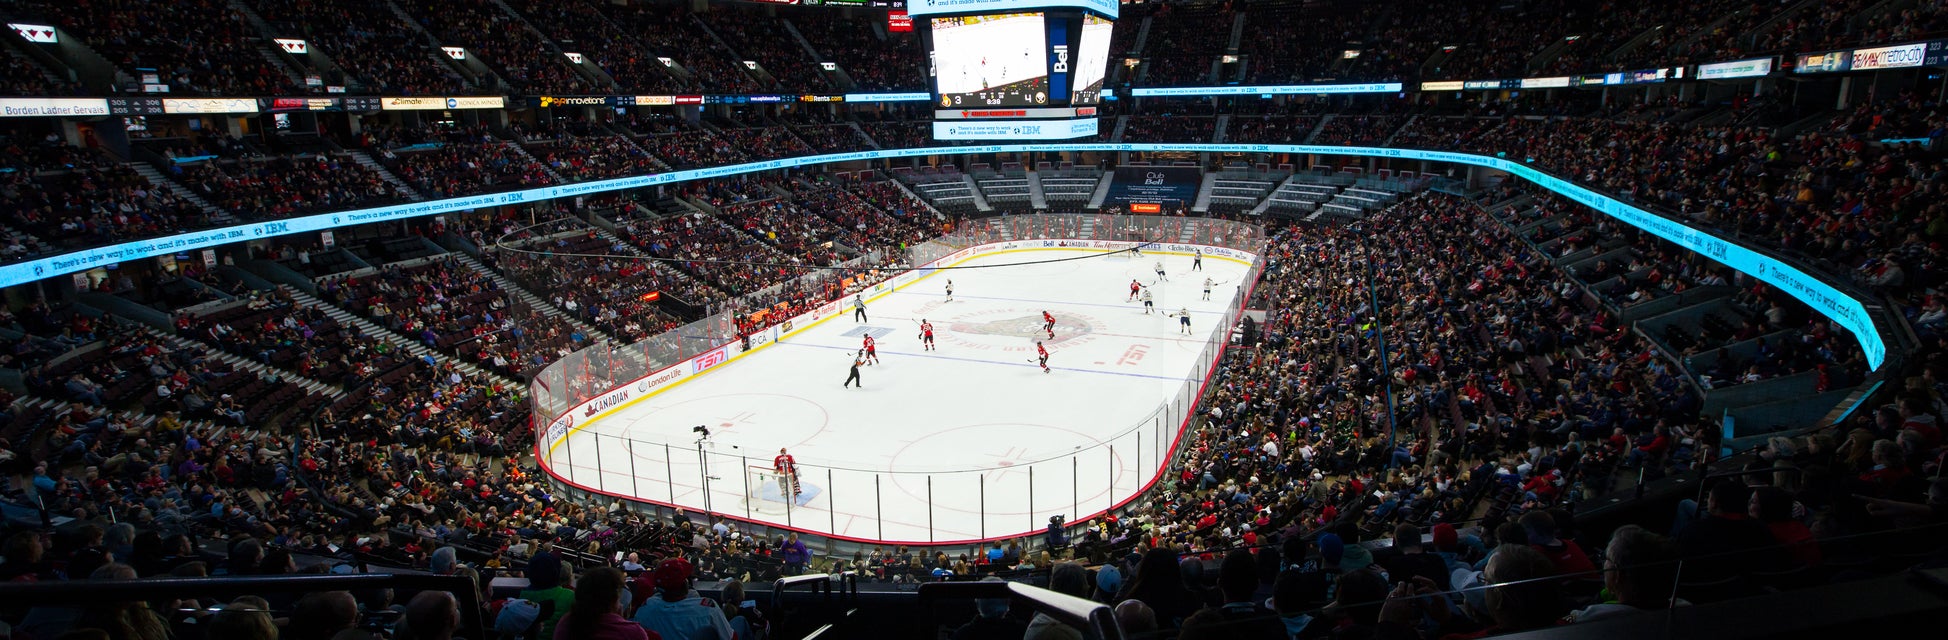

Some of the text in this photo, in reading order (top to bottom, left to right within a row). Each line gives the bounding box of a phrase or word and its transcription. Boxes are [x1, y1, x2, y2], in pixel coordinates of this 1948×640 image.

[1929, 42, 1942, 51] 323
[1054, 45, 1068, 72] Bell
[1852, 46, 1924, 68] RE/MAX metro-city
[1926, 56, 1938, 65] 223
[954, 96, 962, 104] 3
[1024, 94, 1032, 102] 4
[6, 105, 104, 115] Borden Ladner Gervais
[1022, 126, 1040, 135] IBM
[508, 192, 523, 202] IBM
[348, 212, 371, 221] There's
[394, 209, 408, 217] way
[265, 222, 288, 234] IBM
[52, 259, 80, 270] There's
[107, 250, 124, 260] way
[137, 244, 156, 254] work
[158, 241, 174, 250] and
[175, 238, 186, 247] it's
[188, 235, 209, 245] made
[210, 233, 227, 242] with
[1805, 286, 1816, 300] way
[1817, 291, 1821, 302] to
[1822, 296, 1836, 310] work
[1838, 304, 1849, 318] and
[696, 350, 724, 371] TSN
[648, 369, 681, 388] London Life
[595, 390, 628, 412] CANADIAN
